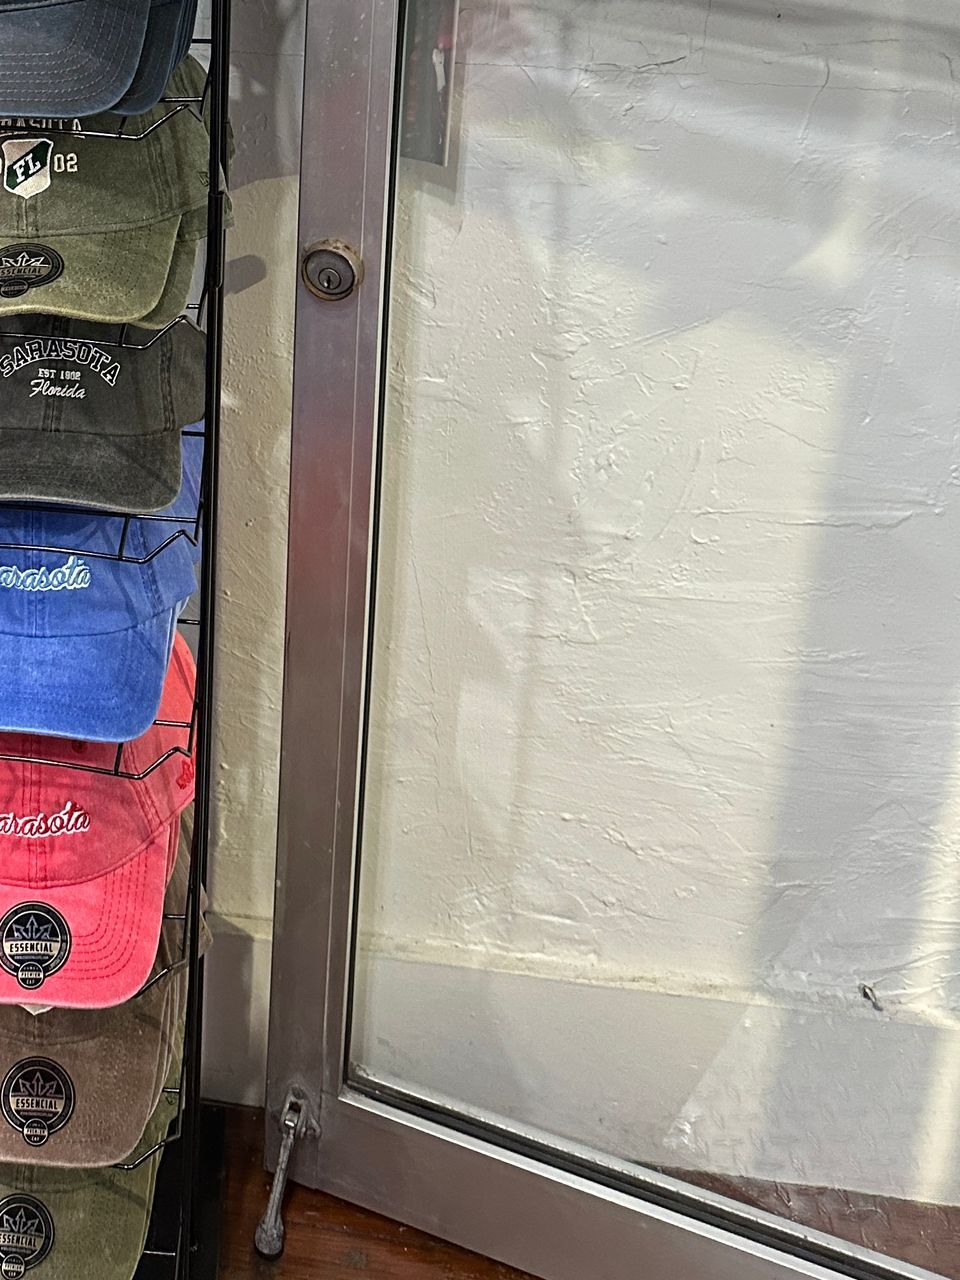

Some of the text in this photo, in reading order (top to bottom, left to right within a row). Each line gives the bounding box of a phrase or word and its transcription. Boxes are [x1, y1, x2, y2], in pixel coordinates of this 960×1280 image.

[13, 153, 41, 183] FL
[54, 153, 78, 172] 02
[37, 368, 56, 379] EST
[29, 379, 87, 399] Florida
[9, 942, 53, 952] ESSENCIAL
[16, 1098, 58, 1110] ESSENCIAL
